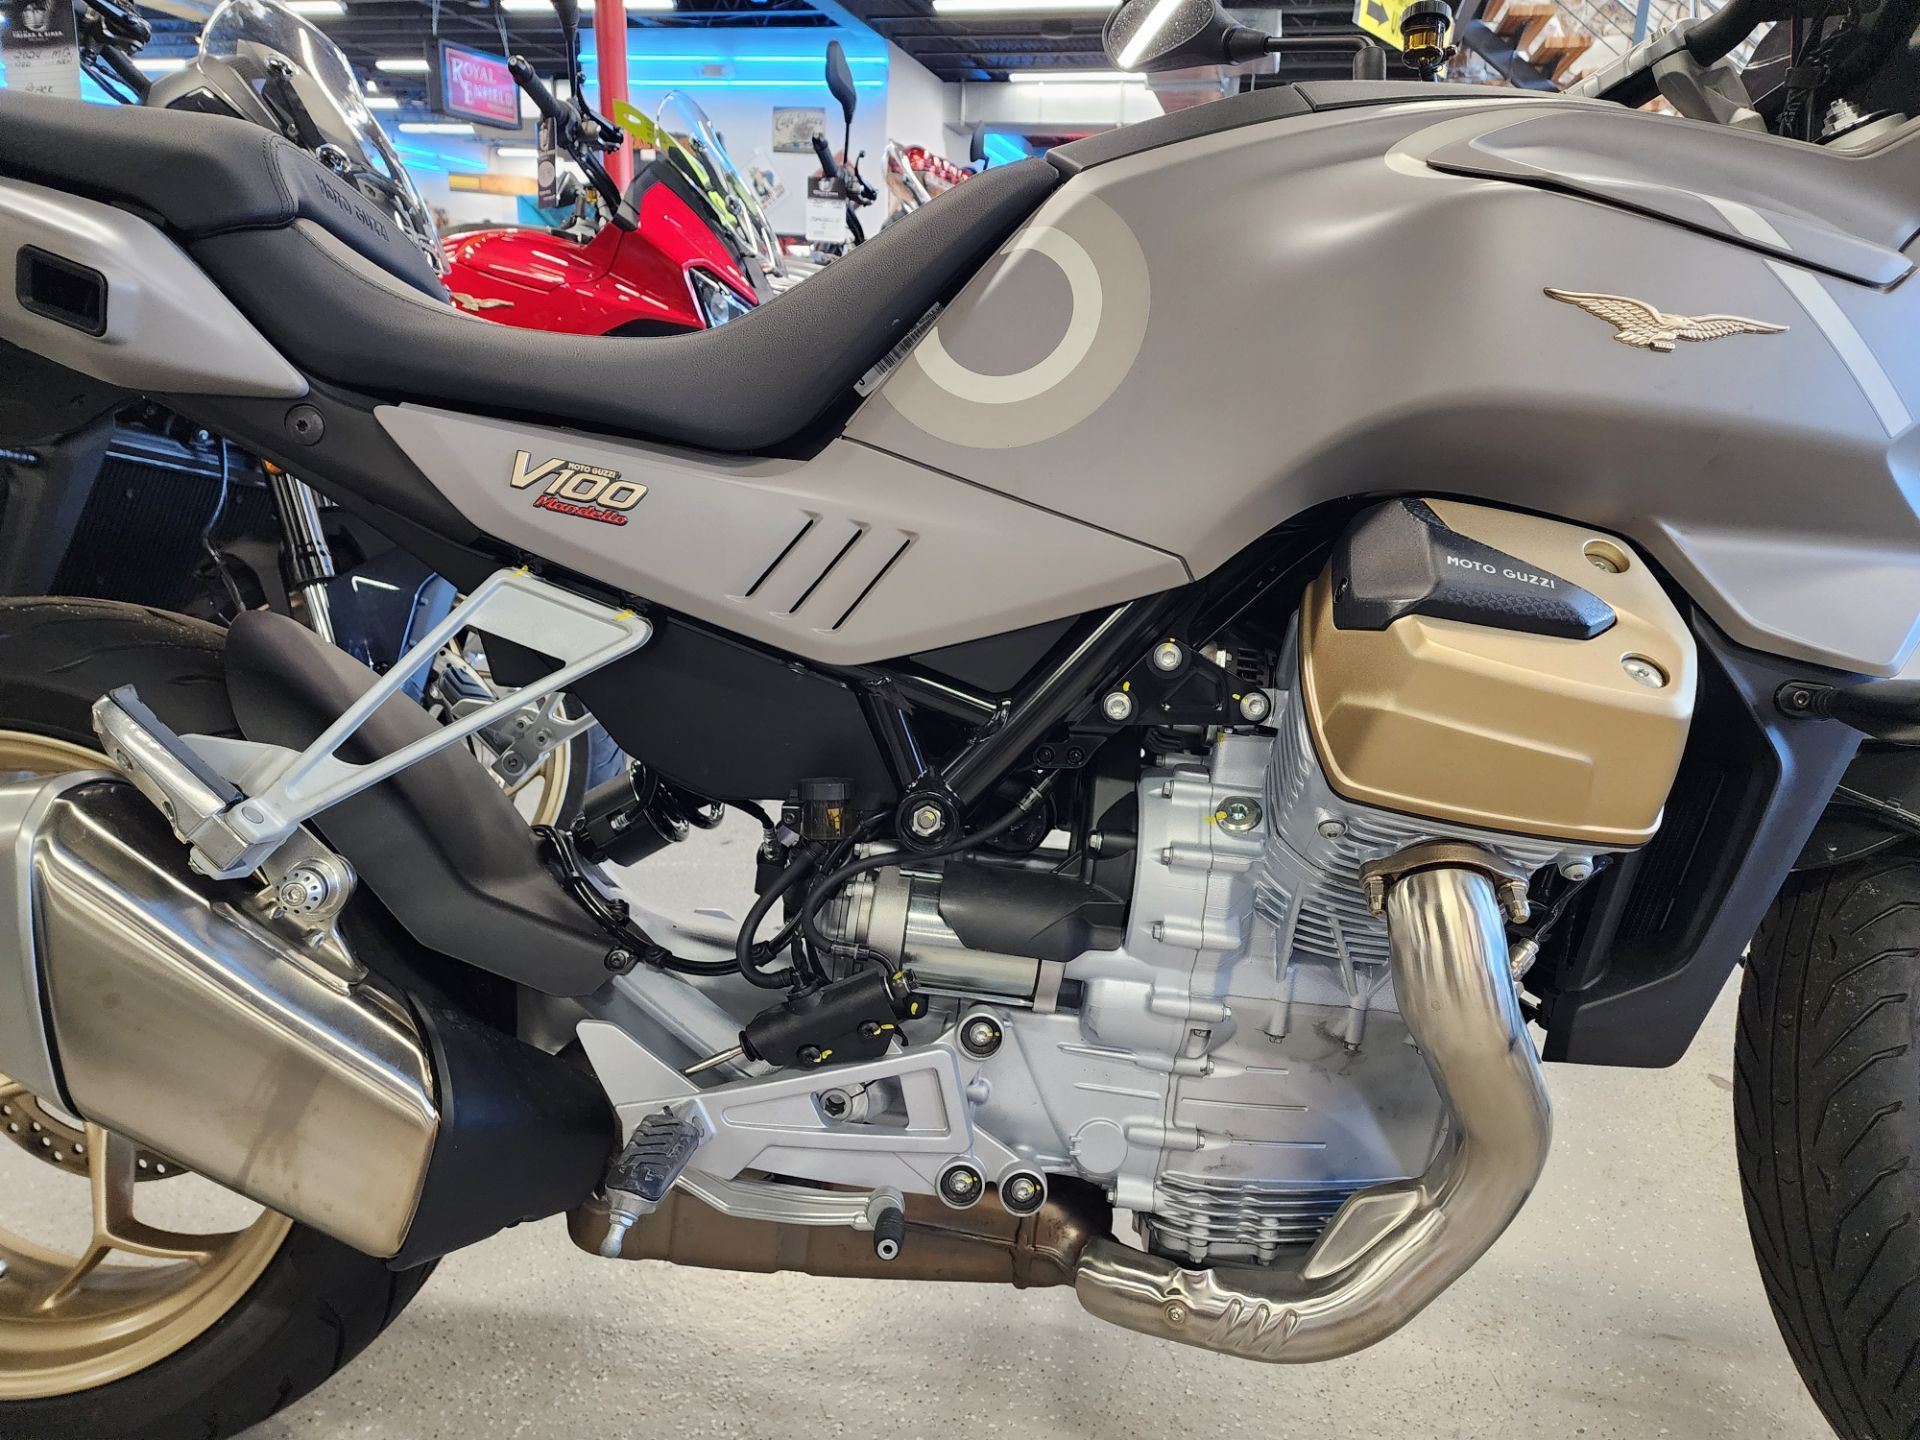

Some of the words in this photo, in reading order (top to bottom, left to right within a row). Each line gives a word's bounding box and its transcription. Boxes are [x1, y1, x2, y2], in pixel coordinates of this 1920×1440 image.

[451, 57, 497, 84] ROYAL
[315, 174, 353, 215] MOTO
[354, 204, 390, 242] GUZZI
[510, 450, 649, 511] V100
[567, 462, 591, 473] MOTO
[591, 467, 617, 479] GUZZI
[533, 495, 628, 526] Mandello
[1446, 555, 1497, 575] MOTO
[1502, 568, 1556, 589] GUZZI
